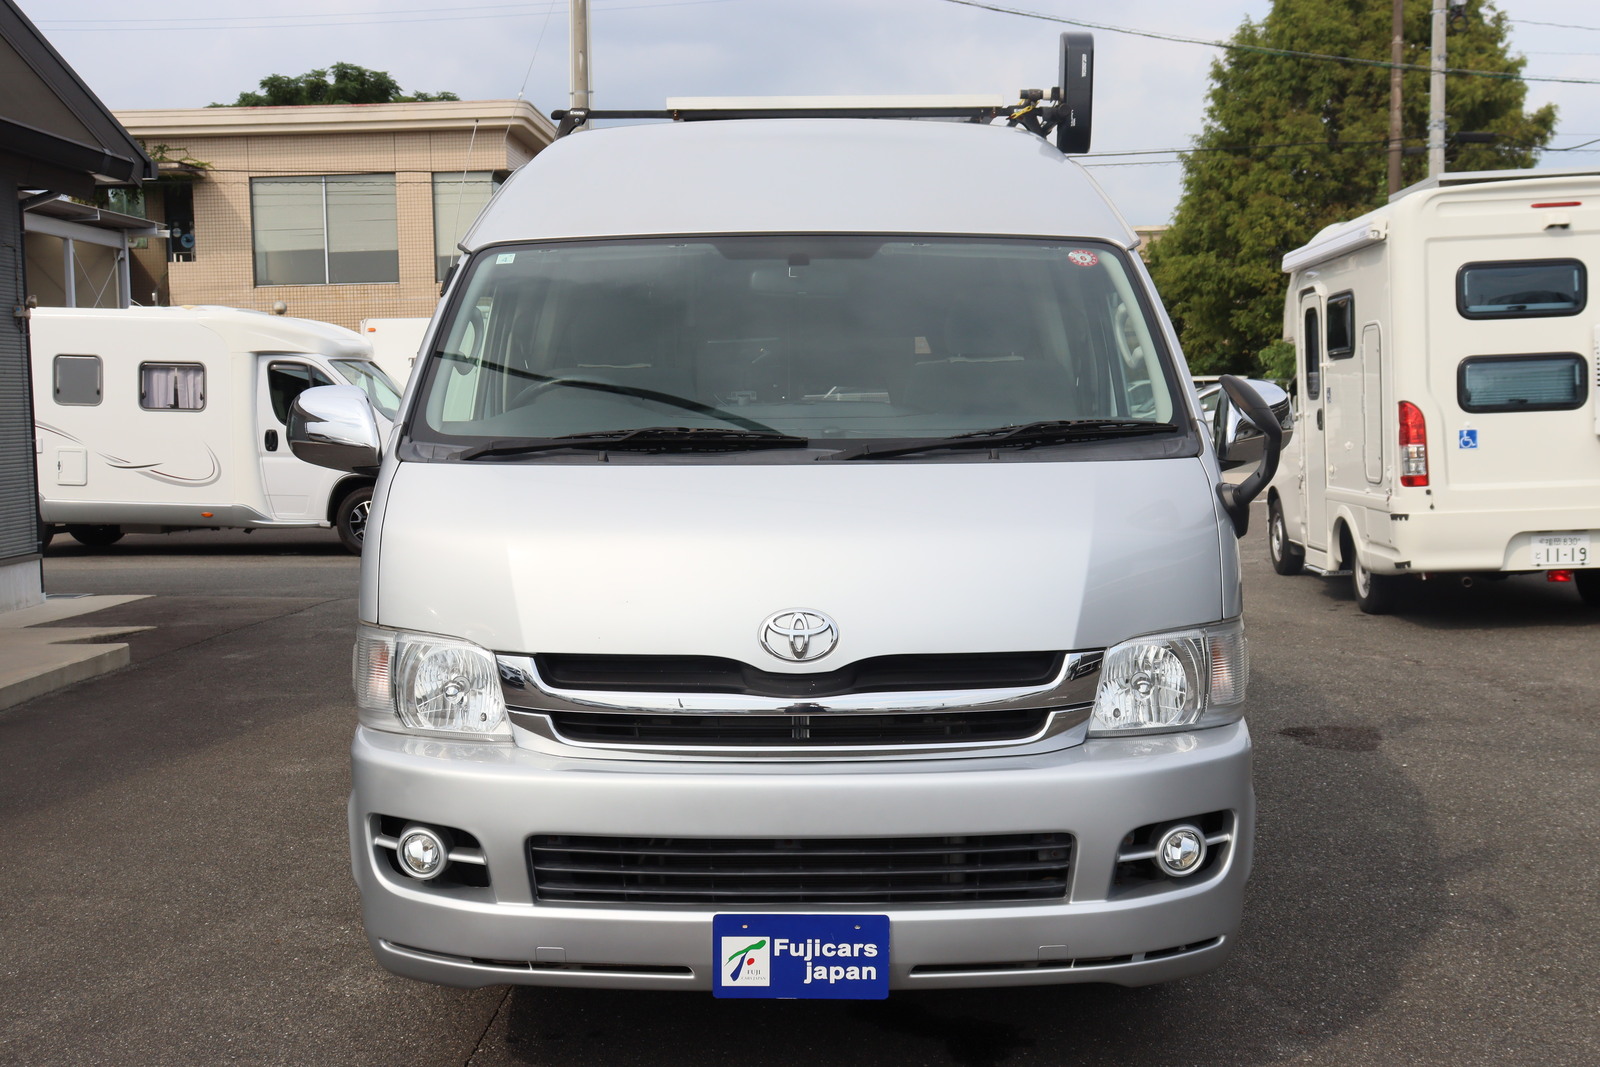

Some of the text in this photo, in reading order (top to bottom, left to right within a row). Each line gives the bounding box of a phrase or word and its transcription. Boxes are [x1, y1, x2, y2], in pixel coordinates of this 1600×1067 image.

[1546, 547, 1587, 562] 11-19
[774, 938, 878, 961] Fujicars
[804, 962, 877, 984] japan
